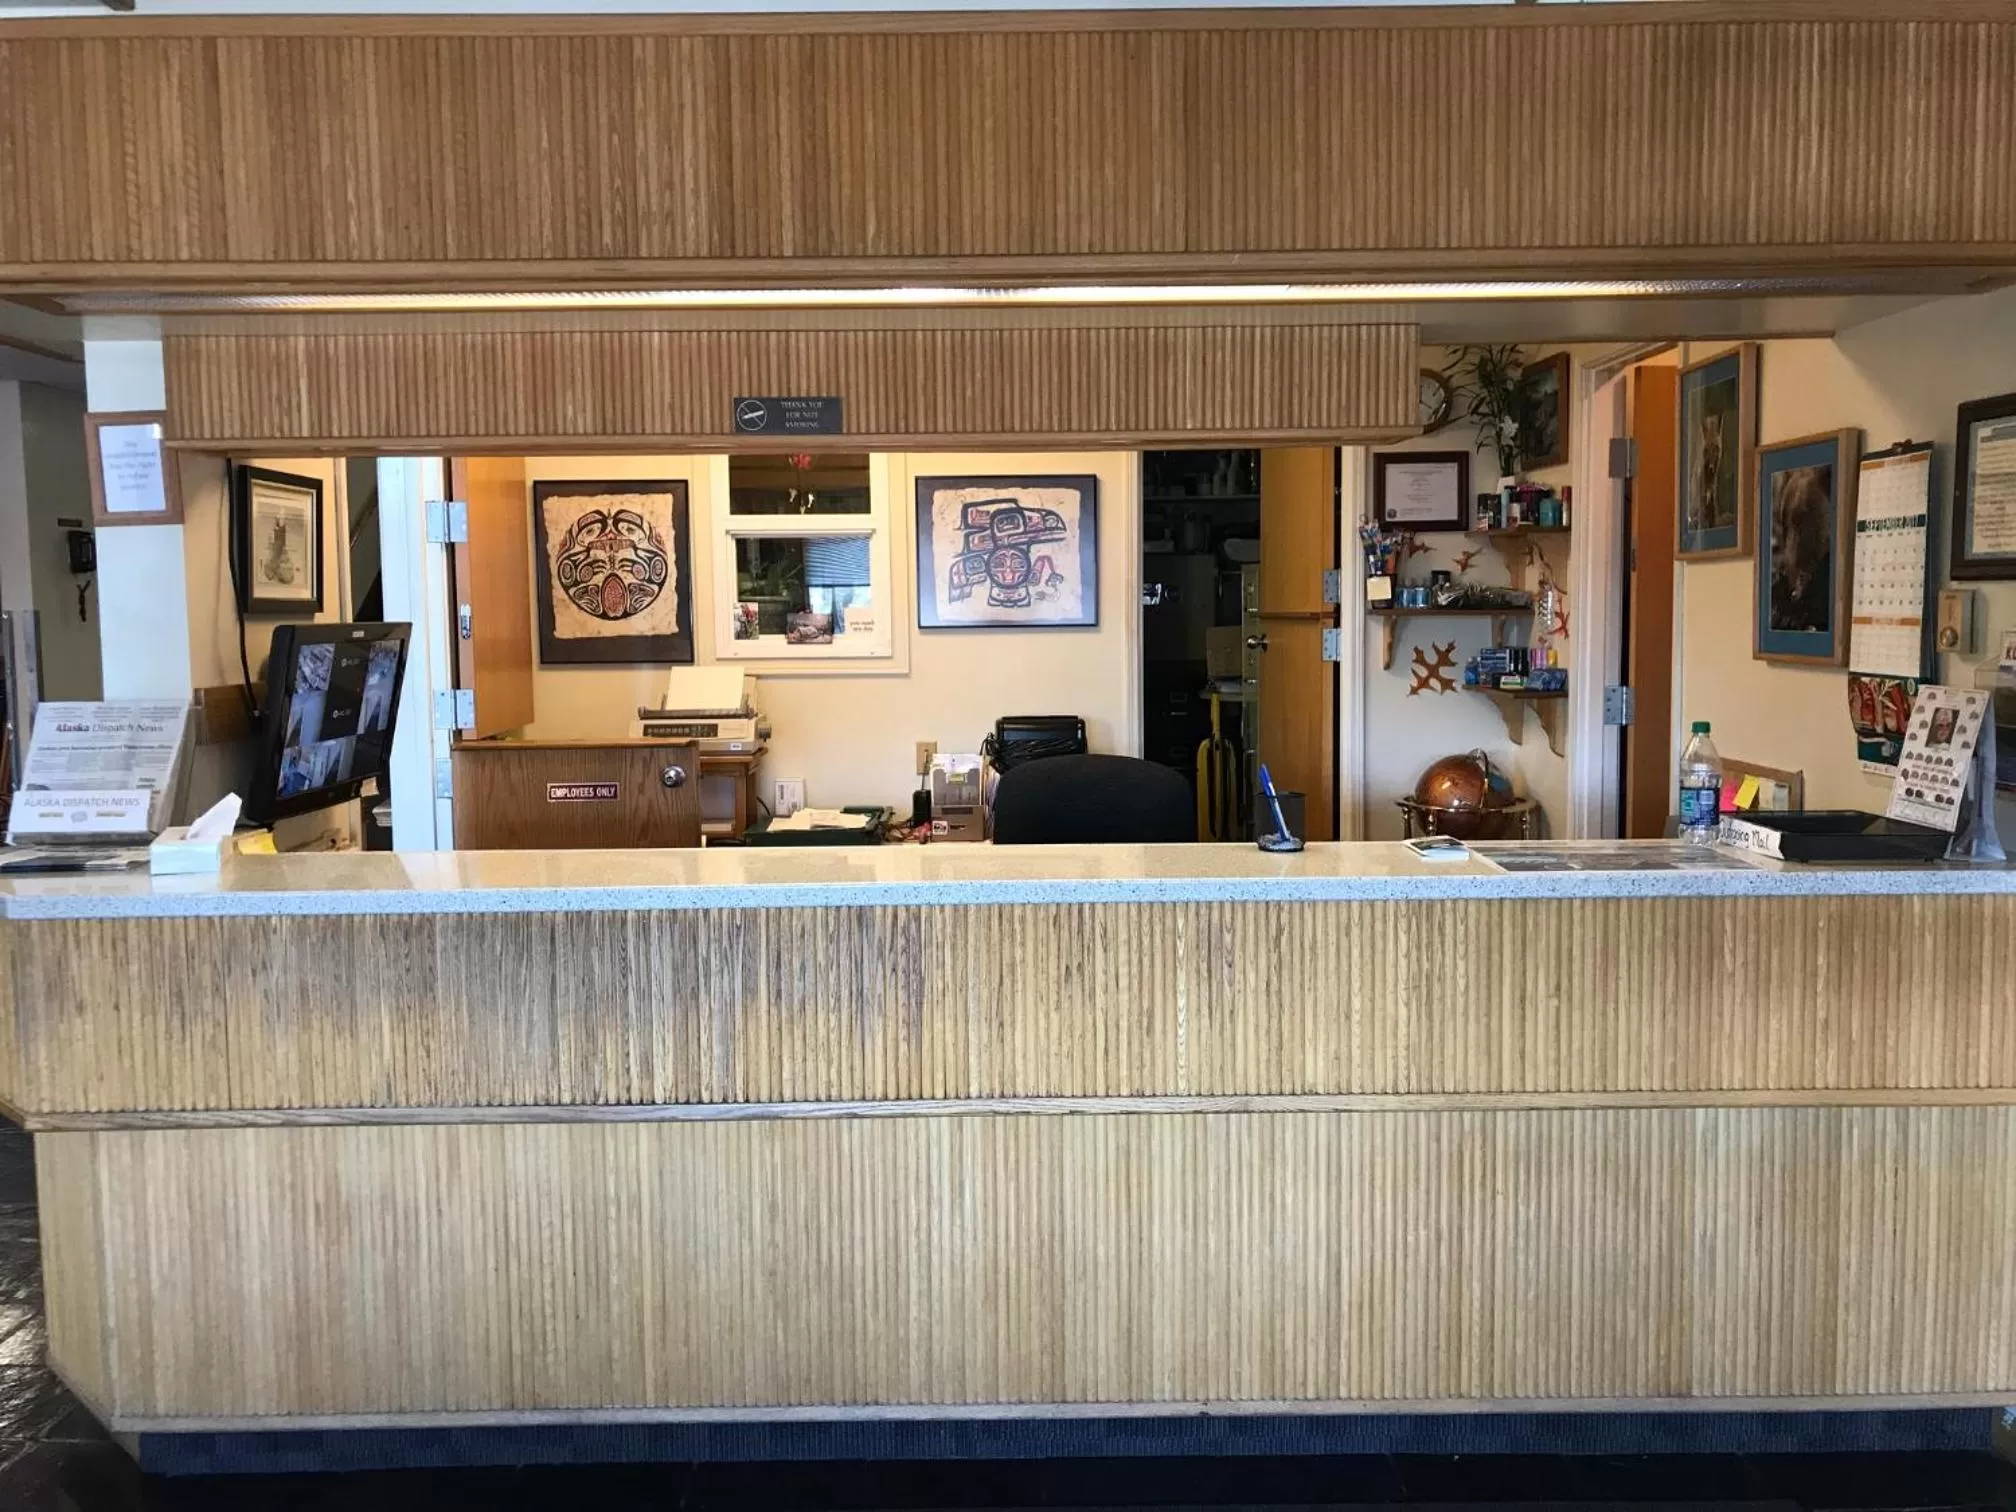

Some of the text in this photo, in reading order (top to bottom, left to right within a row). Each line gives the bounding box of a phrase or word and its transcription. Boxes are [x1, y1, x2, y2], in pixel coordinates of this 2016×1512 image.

[56, 722, 163, 734] Alaska Dispatch News
[551, 786, 615, 797] EMPLOYEES ONLY
[25, 797, 141, 807] ALASKA DISPATCH NEWS
